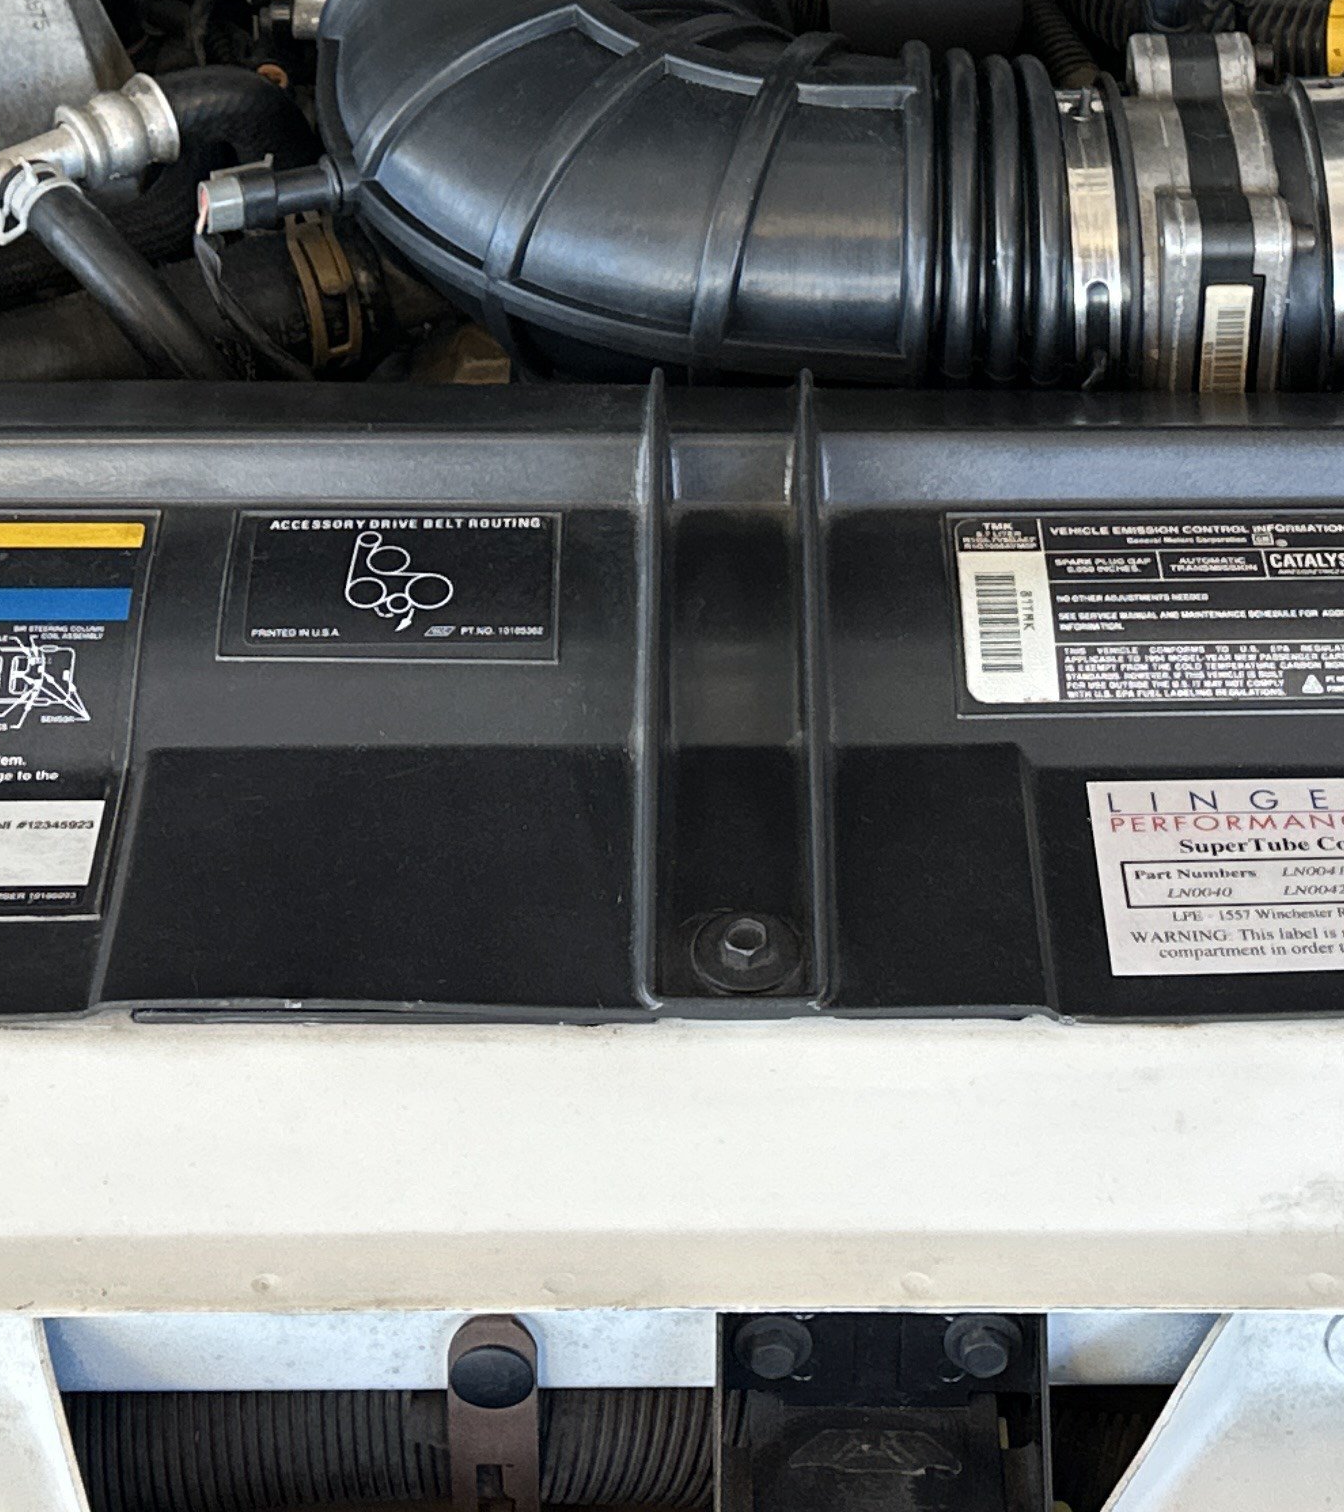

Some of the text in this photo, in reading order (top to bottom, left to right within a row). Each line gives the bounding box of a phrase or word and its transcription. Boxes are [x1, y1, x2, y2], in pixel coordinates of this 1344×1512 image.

[270, 517, 541, 532] ACCESSORY DRIVE BELT ROUTING
[1050, 525, 1110, 536] VEHICLE
[1112, 525, 1180, 535] EMISSION
[1182, 525, 1249, 534] CONTROL
[1179, 837, 1309, 856] SuperTube
[1134, 869, 1172, 880] Part
[1176, 868, 1257, 879] Numbers
[1167, 887, 1233, 899] LN0040
[1240, 928, 1275, 942] This
[1278, 928, 1318, 940] label
[1323, 928, 1336, 939] is
[1159, 945, 1266, 960] compartment
[1271, 944, 1286, 955] in
[1291, 942, 1334, 954] order
